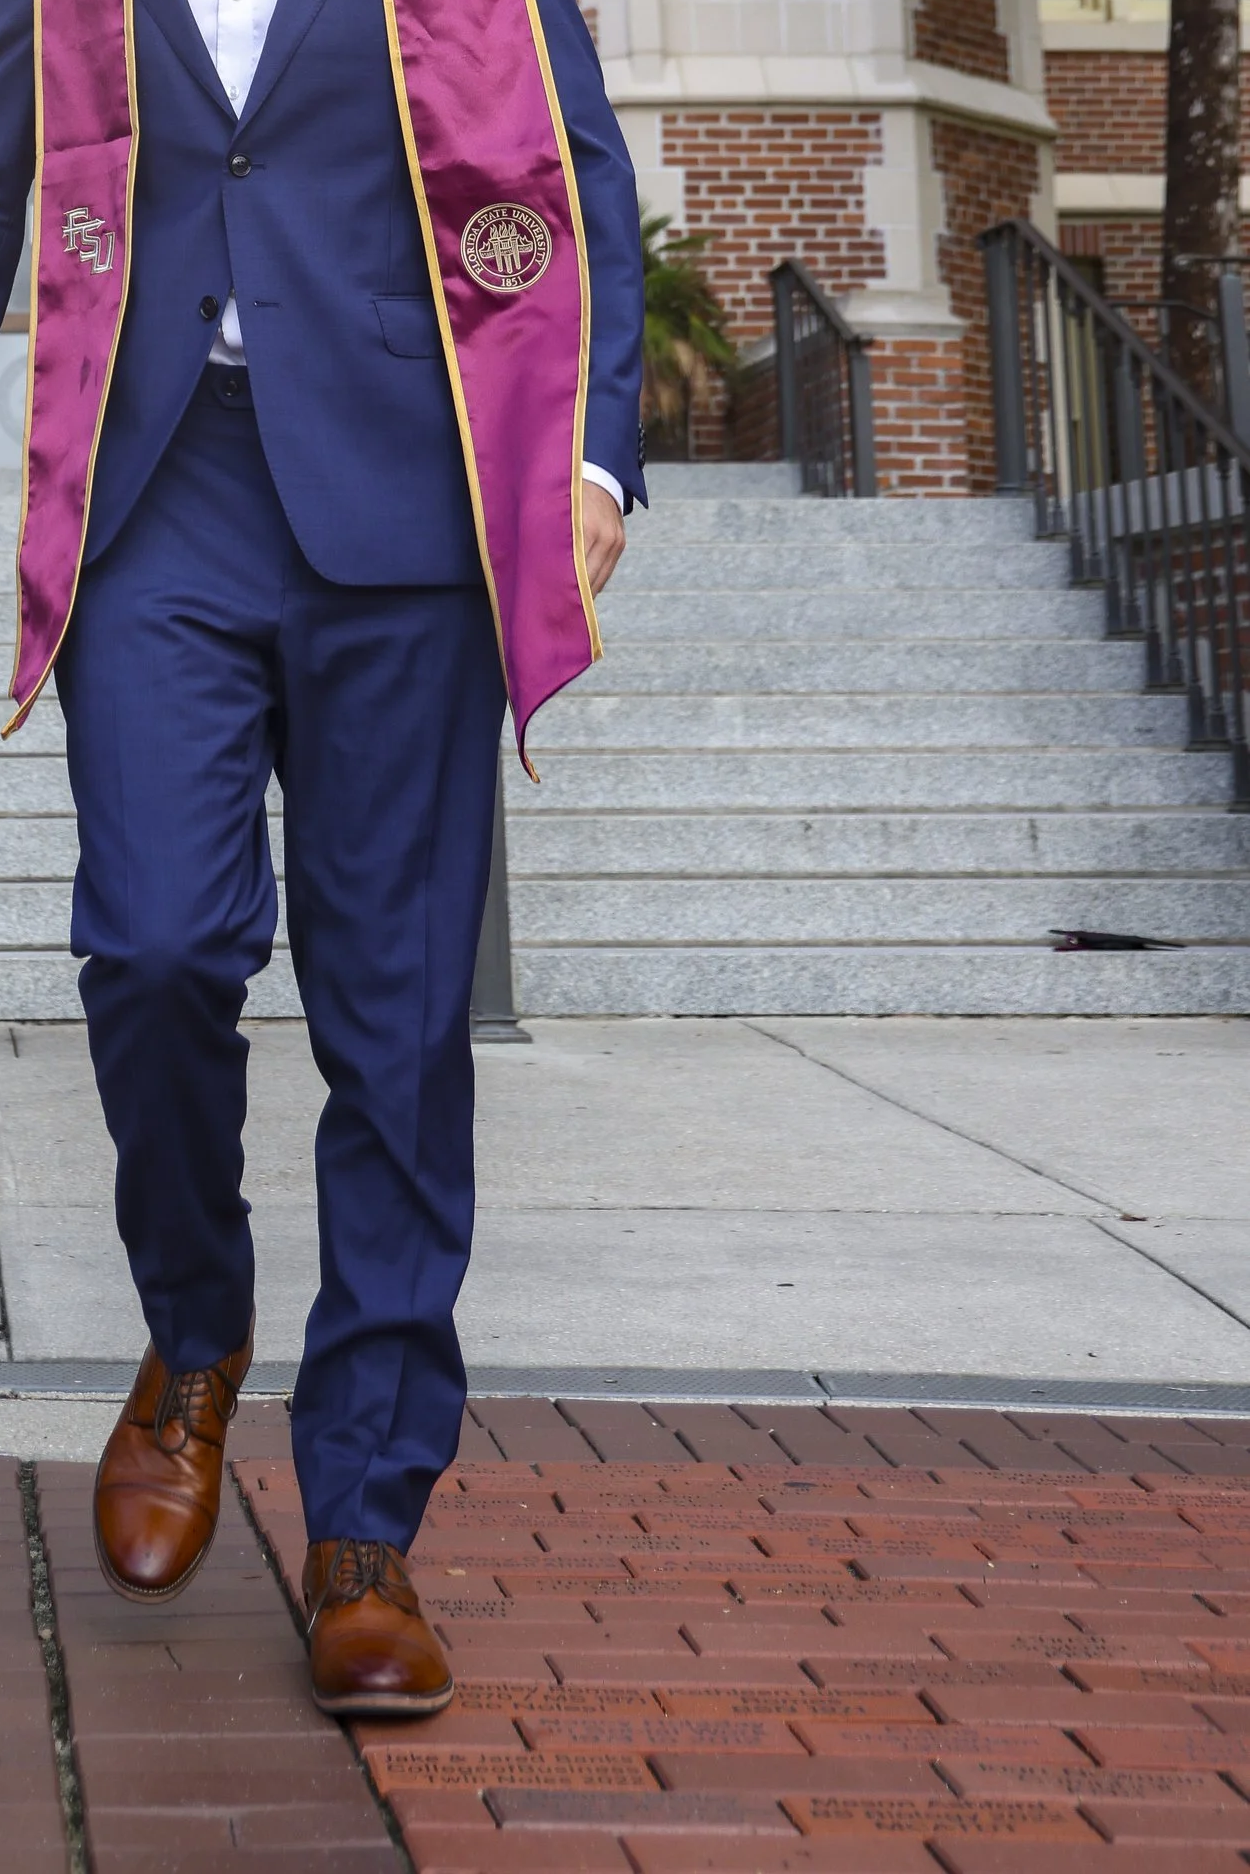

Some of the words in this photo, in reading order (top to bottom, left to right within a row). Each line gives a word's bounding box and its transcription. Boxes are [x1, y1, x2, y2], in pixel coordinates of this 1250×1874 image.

[62, 207, 115, 275] FSU
[466, 227, 484, 276] FLORIDA
[477, 208, 508, 227] STATE
[512, 209, 546, 266] UNIVERSITY
[500, 276, 524, 287] 1851
